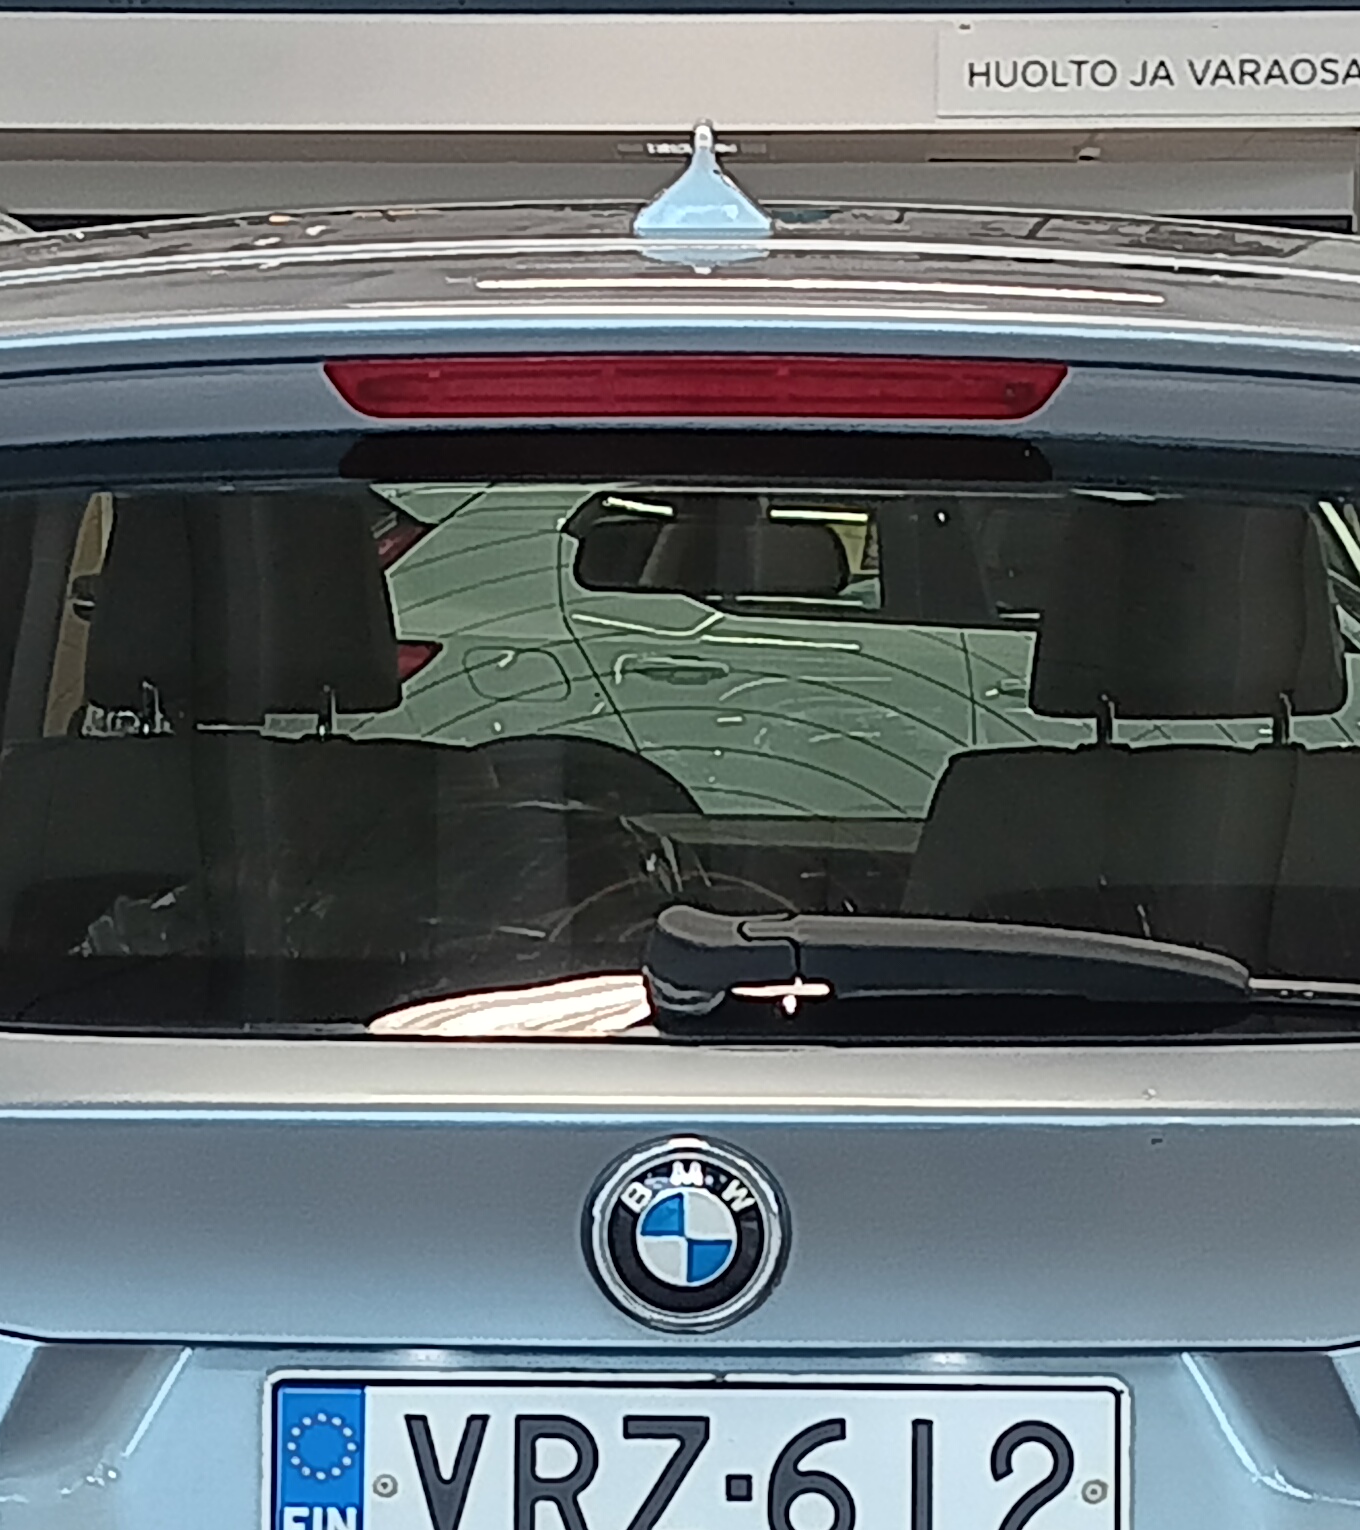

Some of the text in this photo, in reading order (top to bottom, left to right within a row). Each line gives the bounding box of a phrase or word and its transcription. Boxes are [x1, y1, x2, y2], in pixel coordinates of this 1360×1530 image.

[967, 58, 1117, 88] HUOLTO
[1129, 58, 1175, 87] JA
[620, 1160, 756, 1214] BMW
